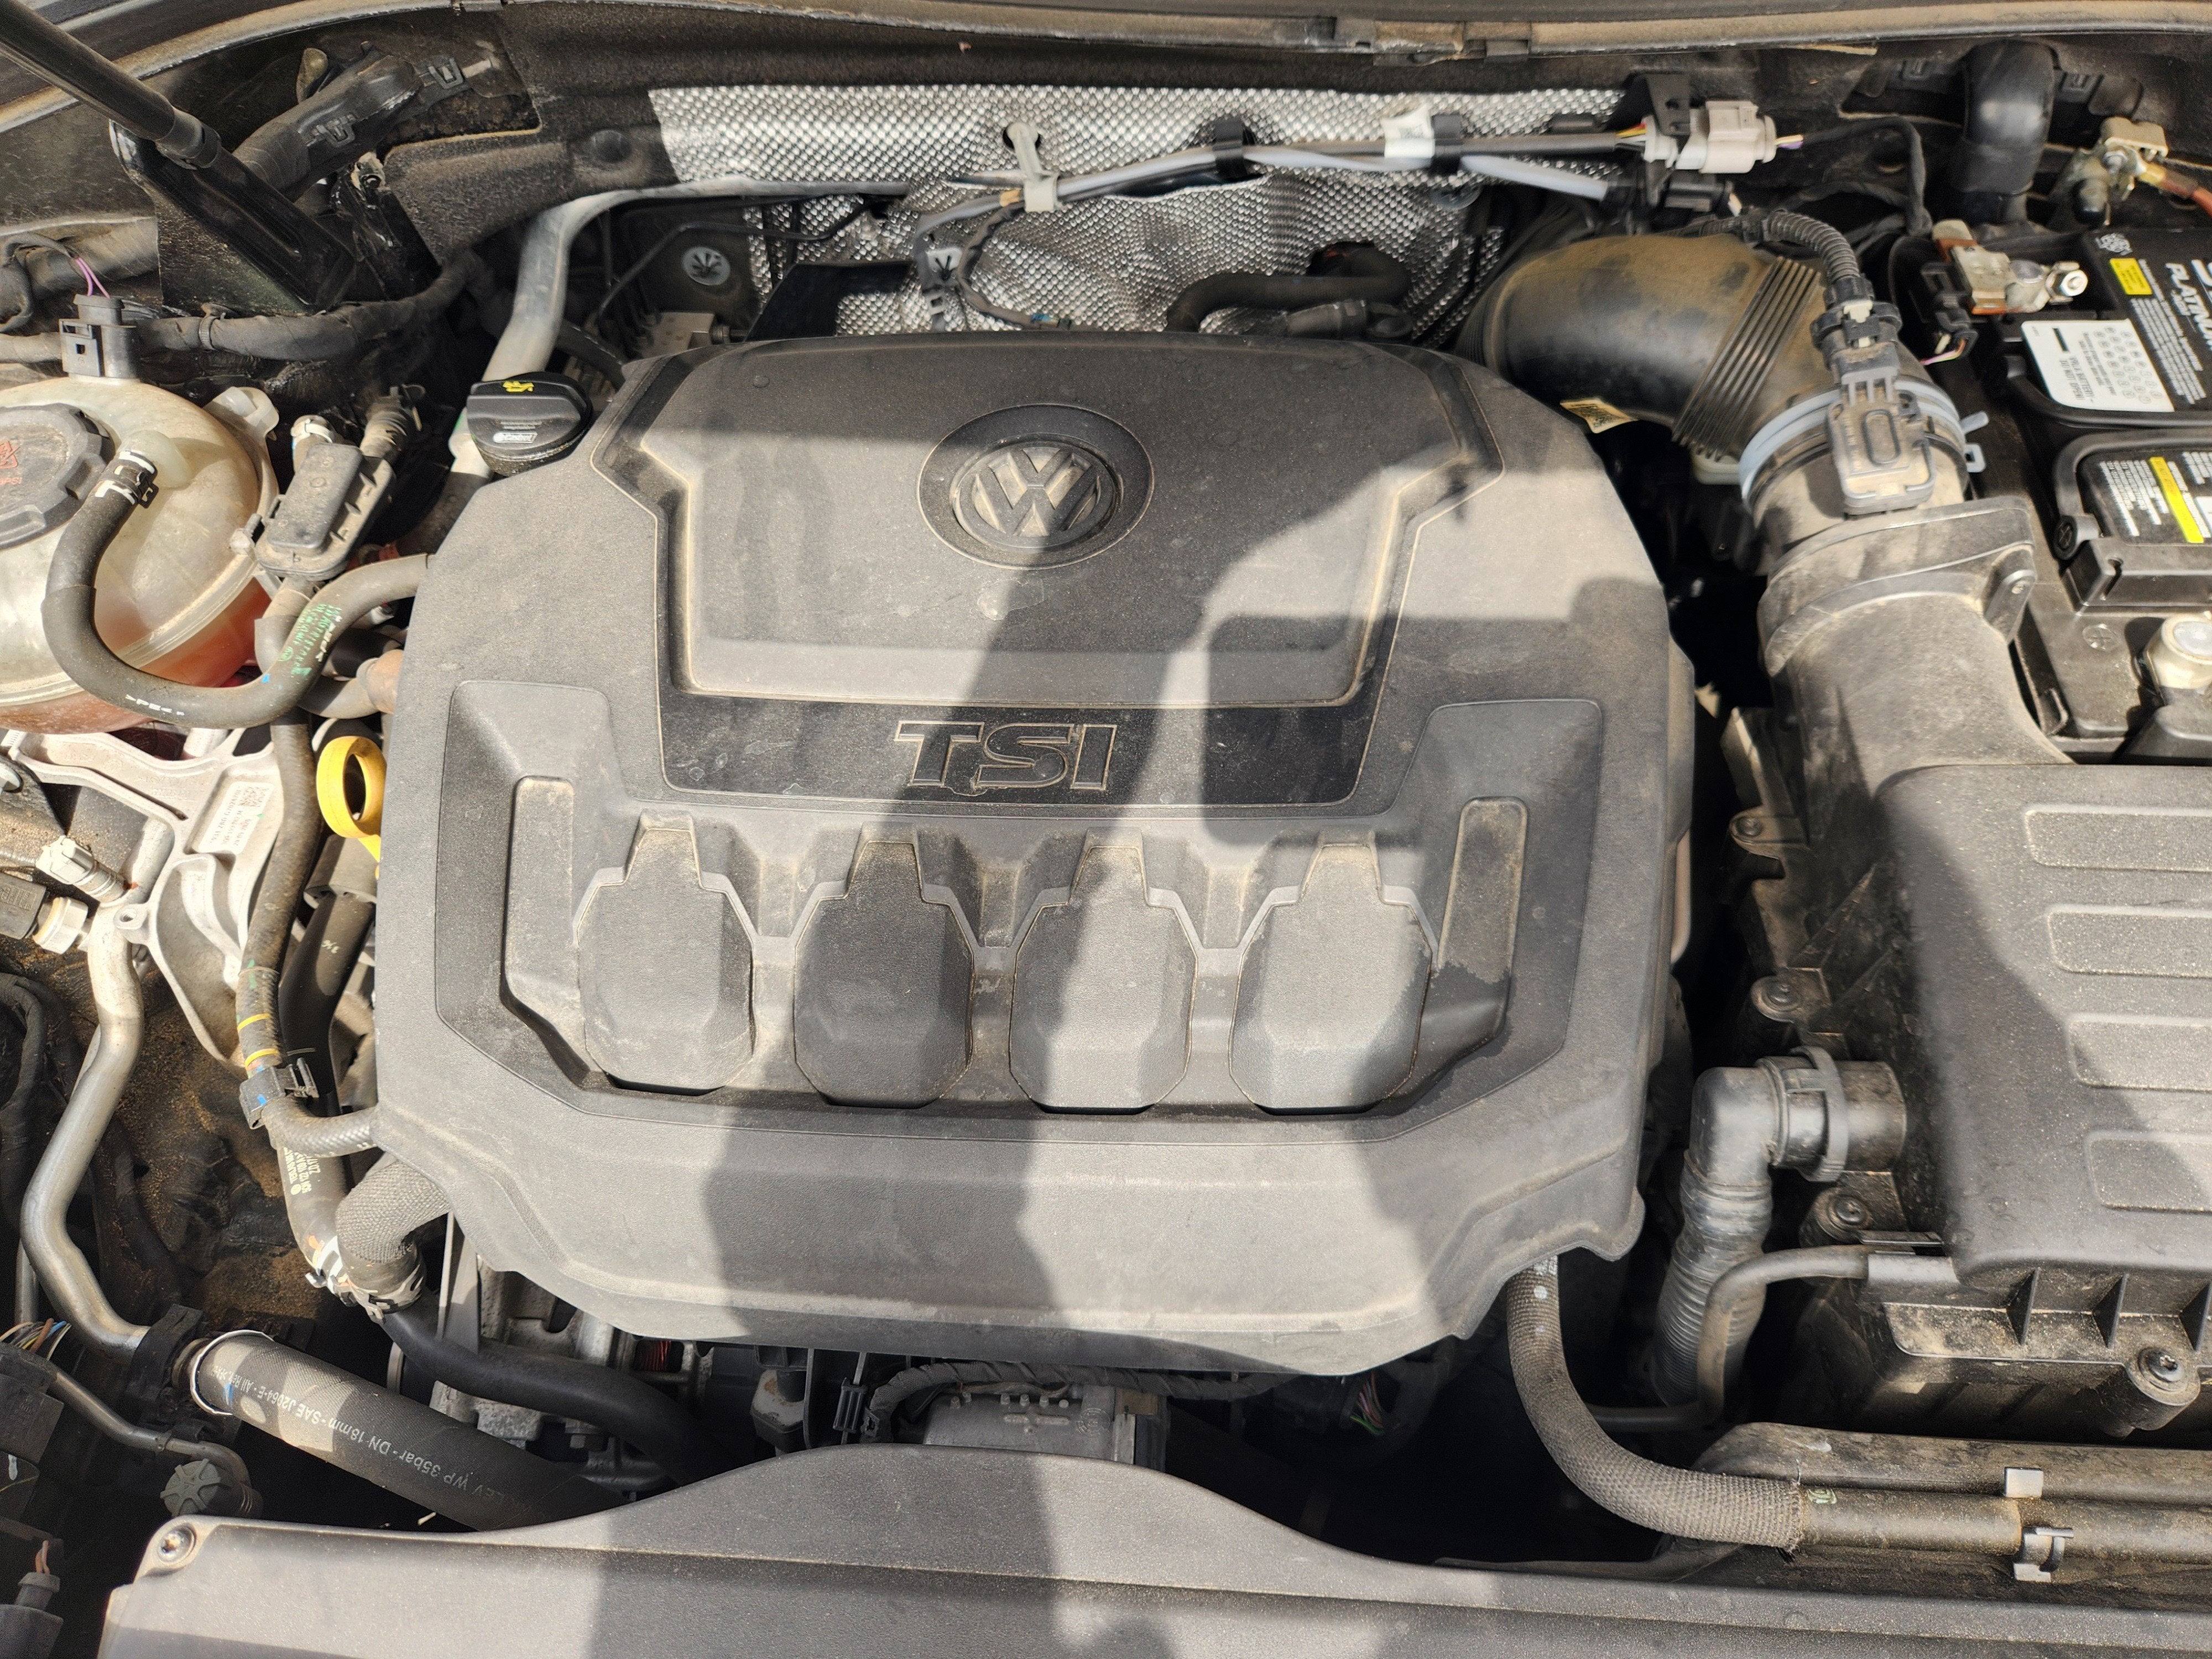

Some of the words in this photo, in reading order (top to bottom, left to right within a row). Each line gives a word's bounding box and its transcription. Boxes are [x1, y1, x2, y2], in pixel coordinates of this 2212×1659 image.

[958, 442, 1114, 545] VW
[894, 721, 1117, 790] TSI
[240, 1379, 254, 1393] All
[257, 1386, 297, 1411] J2064-E
[295, 1404, 321, 1425] SAE
[328, 1417, 365, 1443] 18mm
[368, 1436, 392, 1455] DN
[399, 1449, 441, 1478] 35bar
[444, 1472, 469, 1490] WP
